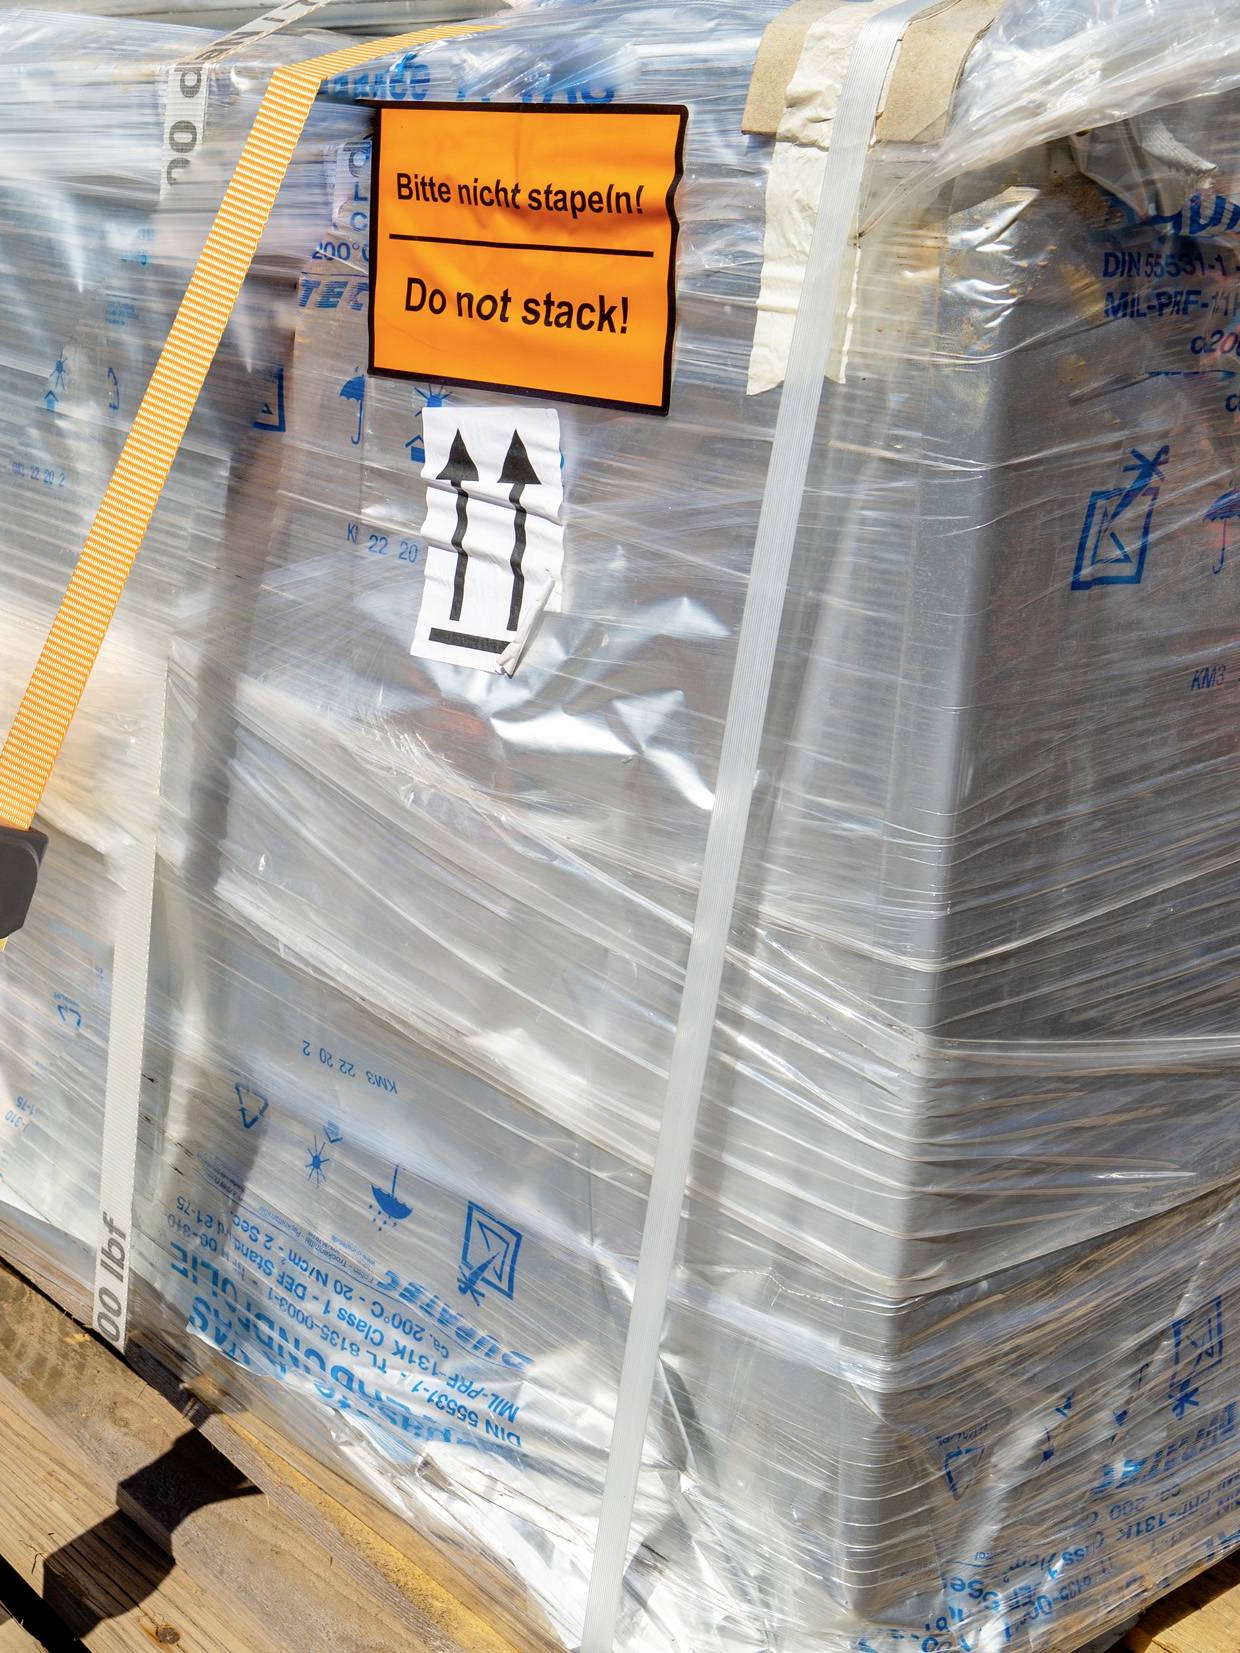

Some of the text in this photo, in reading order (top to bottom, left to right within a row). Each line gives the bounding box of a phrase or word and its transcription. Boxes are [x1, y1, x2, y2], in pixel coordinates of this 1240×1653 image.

[396, 172, 645, 219] Bitte nicht stapeln!
[1102, 251, 1142, 278] DIN
[404, 277, 630, 335] Do not stack!
[368, 533, 389, 555] 22
[399, 539, 420, 564] 20
[301, 1039, 396, 1094] KM3 22 20 2
[99, 1210, 126, 1282] lbf
[229, 1210, 261, 1242] Sec.
[259, 1233, 275, 1250] 2
[274, 1269, 308, 1301] DEF
[331, 1278, 354, 1301] 20
[266, 1286, 361, 1357] 8135-0003-1
[320, 1299, 334, 1316] 1
[335, 1305, 385, 1348] Class
[368, 1299, 427, 1342] 200°C
[374, 1269, 535, 1373] DUPATEC
[365, 1349, 388, 1374] TL
[389, 1338, 519, 1423] MIL-PRF-131K
[408, 1379, 480, 1427] 55531-1
